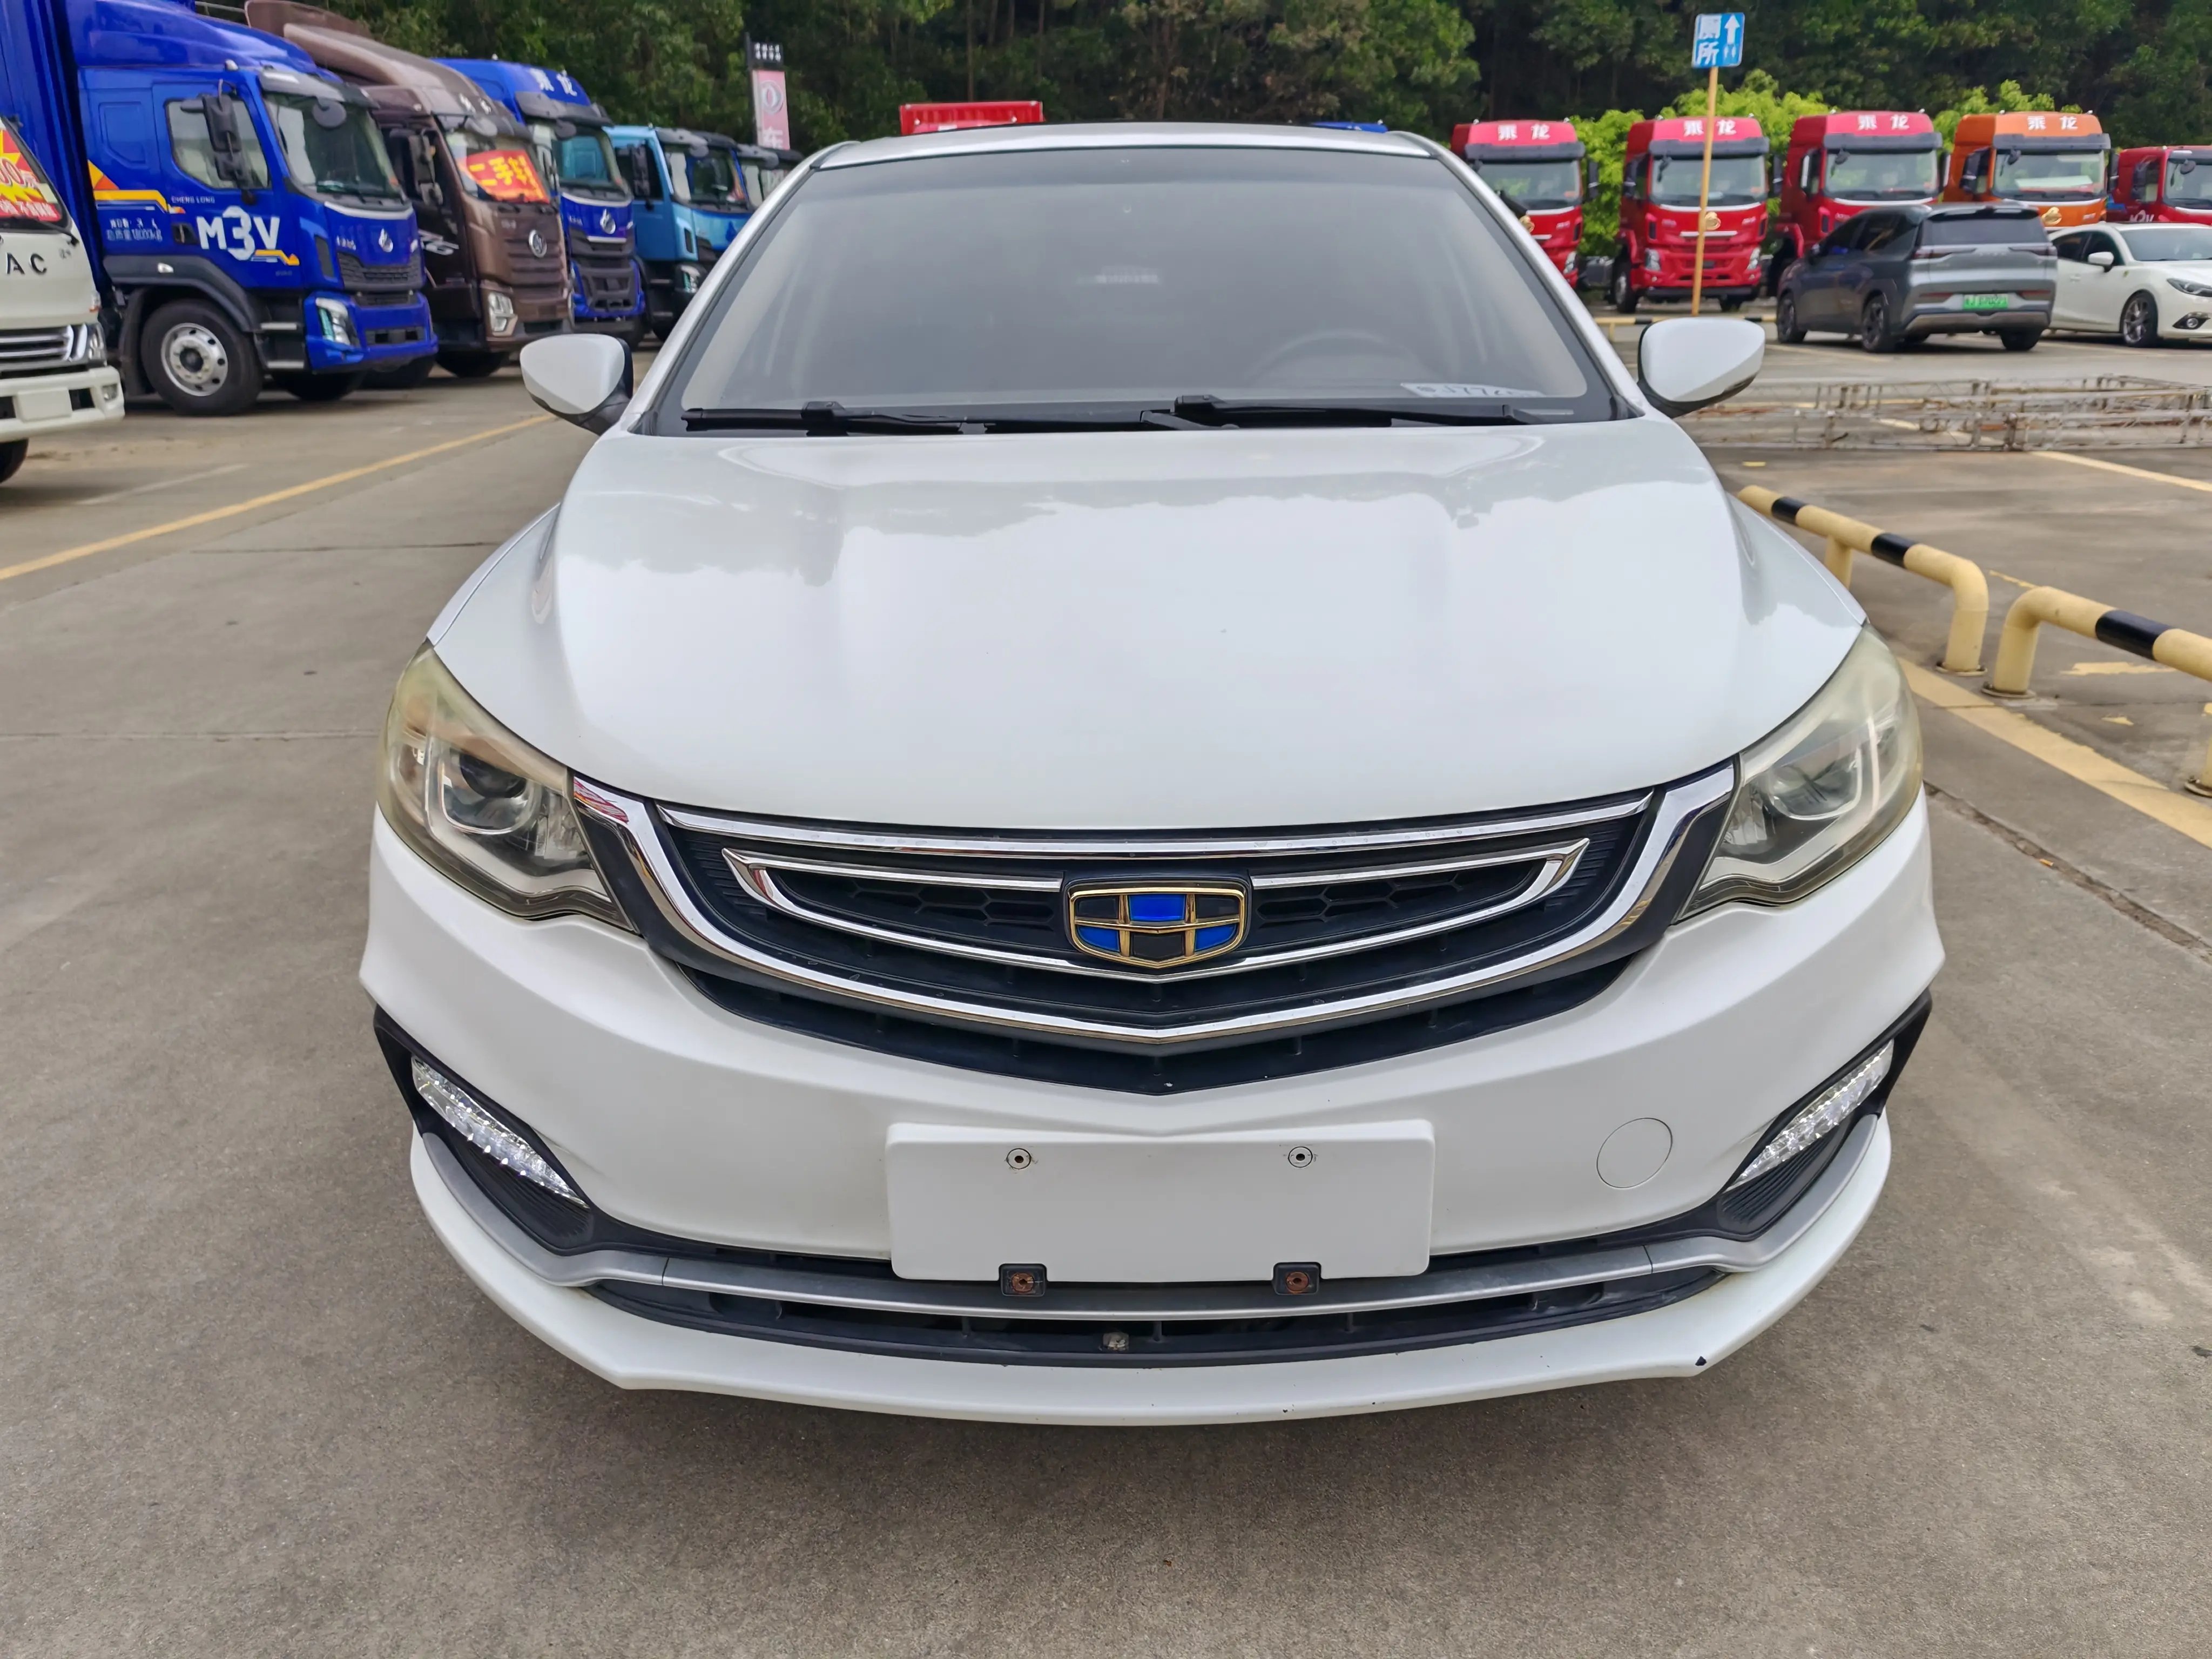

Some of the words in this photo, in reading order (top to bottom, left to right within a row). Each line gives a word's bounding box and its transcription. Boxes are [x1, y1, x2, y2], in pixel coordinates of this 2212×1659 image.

[1858, 114, 1910, 130] 乘龙
[2027, 115, 2078, 130] 乘龙
[197, 205, 280, 261] M3V
